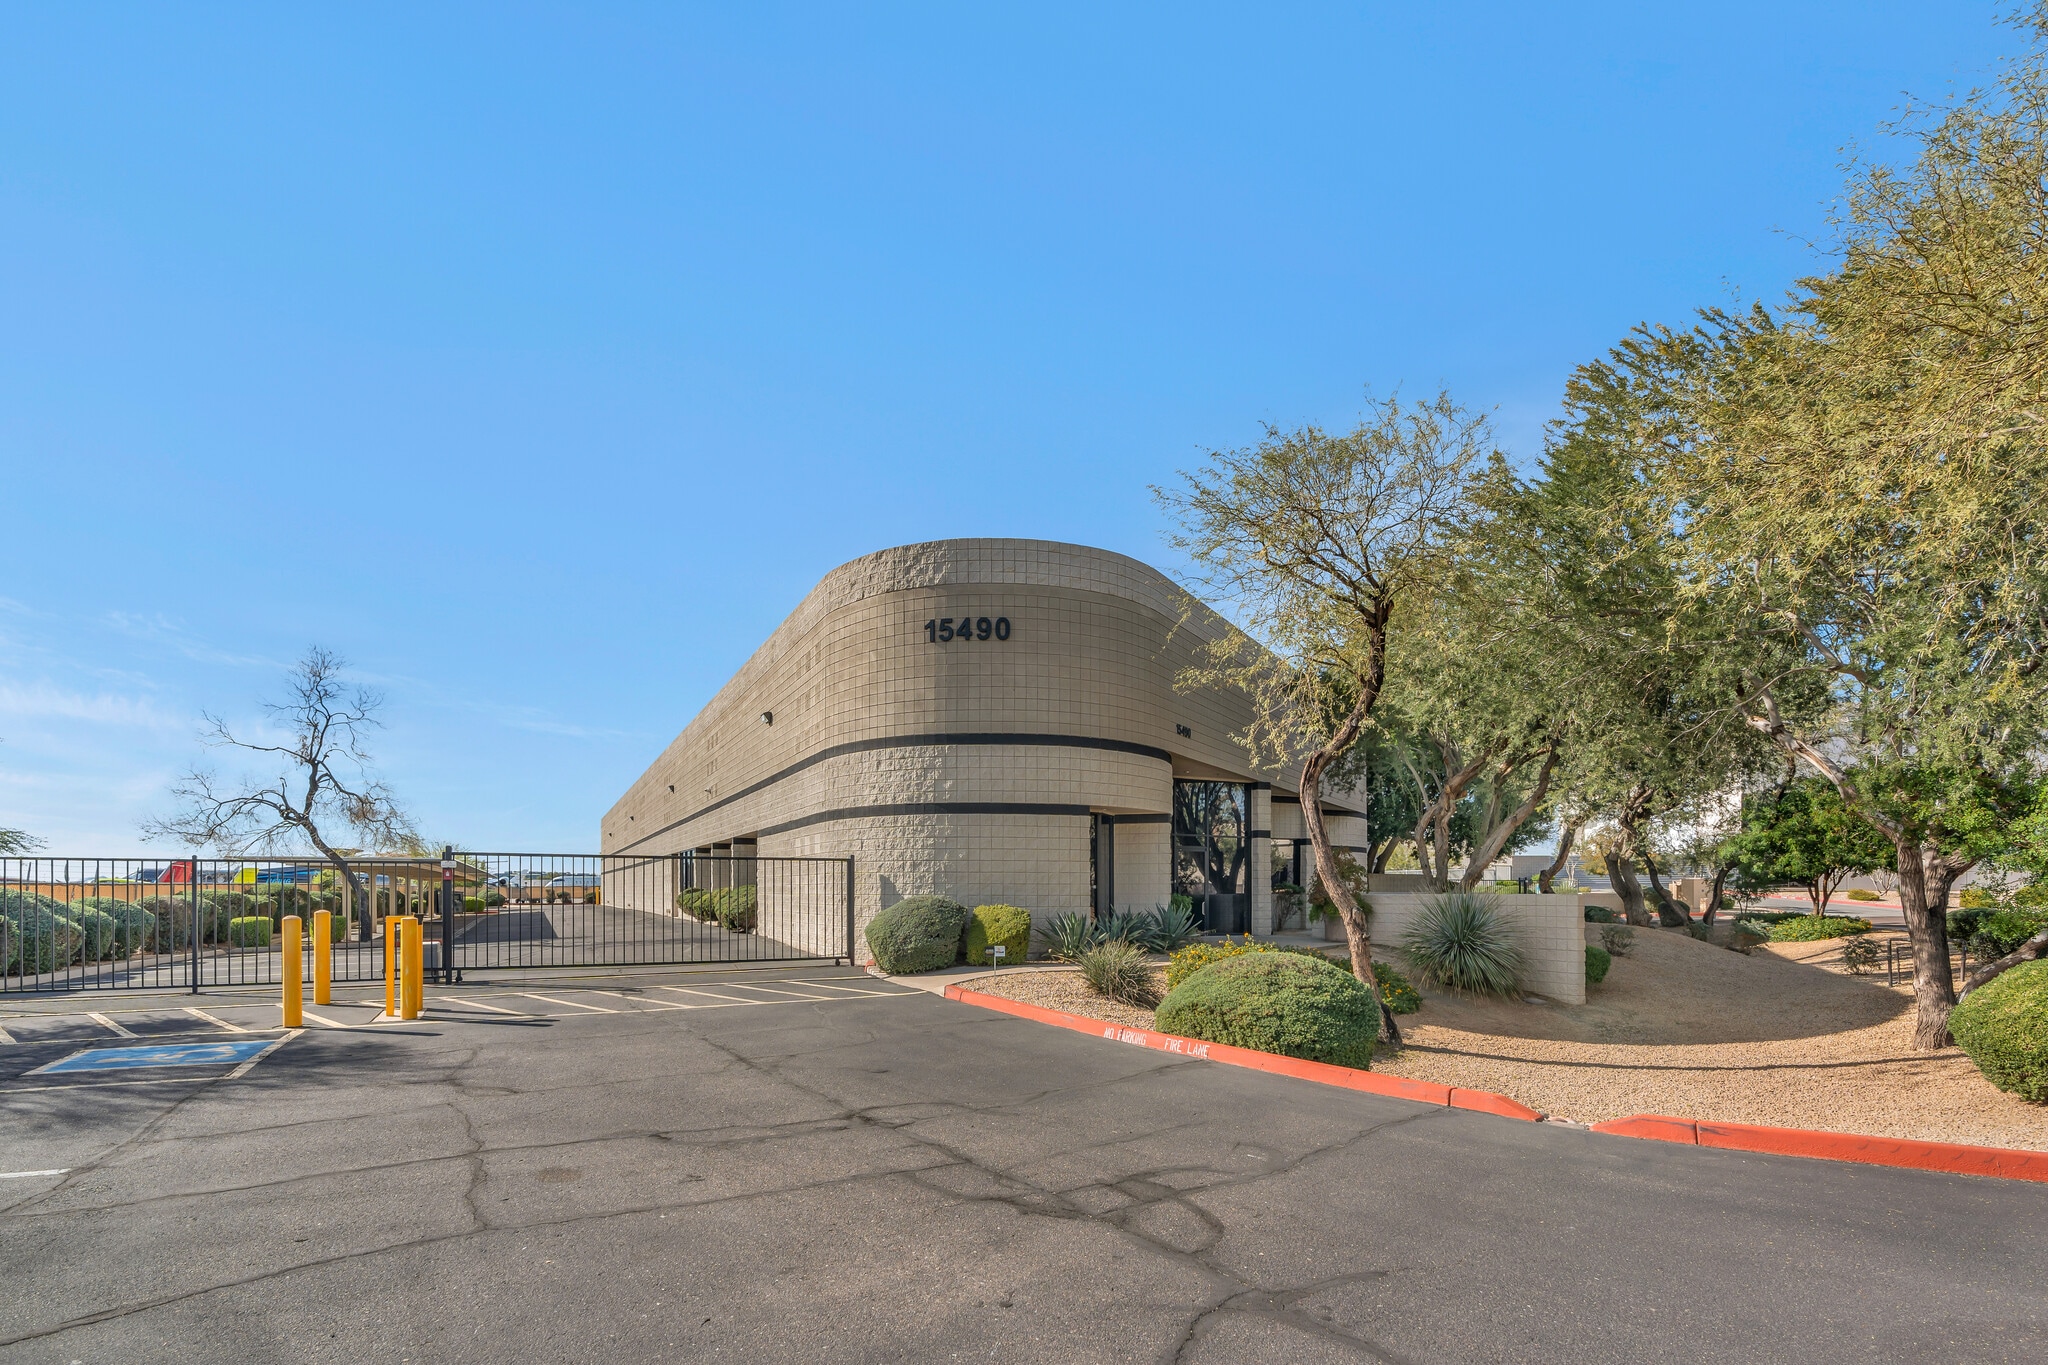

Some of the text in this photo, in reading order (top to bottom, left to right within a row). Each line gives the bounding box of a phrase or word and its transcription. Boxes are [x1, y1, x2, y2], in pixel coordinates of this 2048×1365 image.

[924, 617, 1011, 643] 15490
[1103, 1027, 1115, 1040] NO
[1164, 1038, 1184, 1053] FIRE
[1187, 1042, 1211, 1058] LANE
